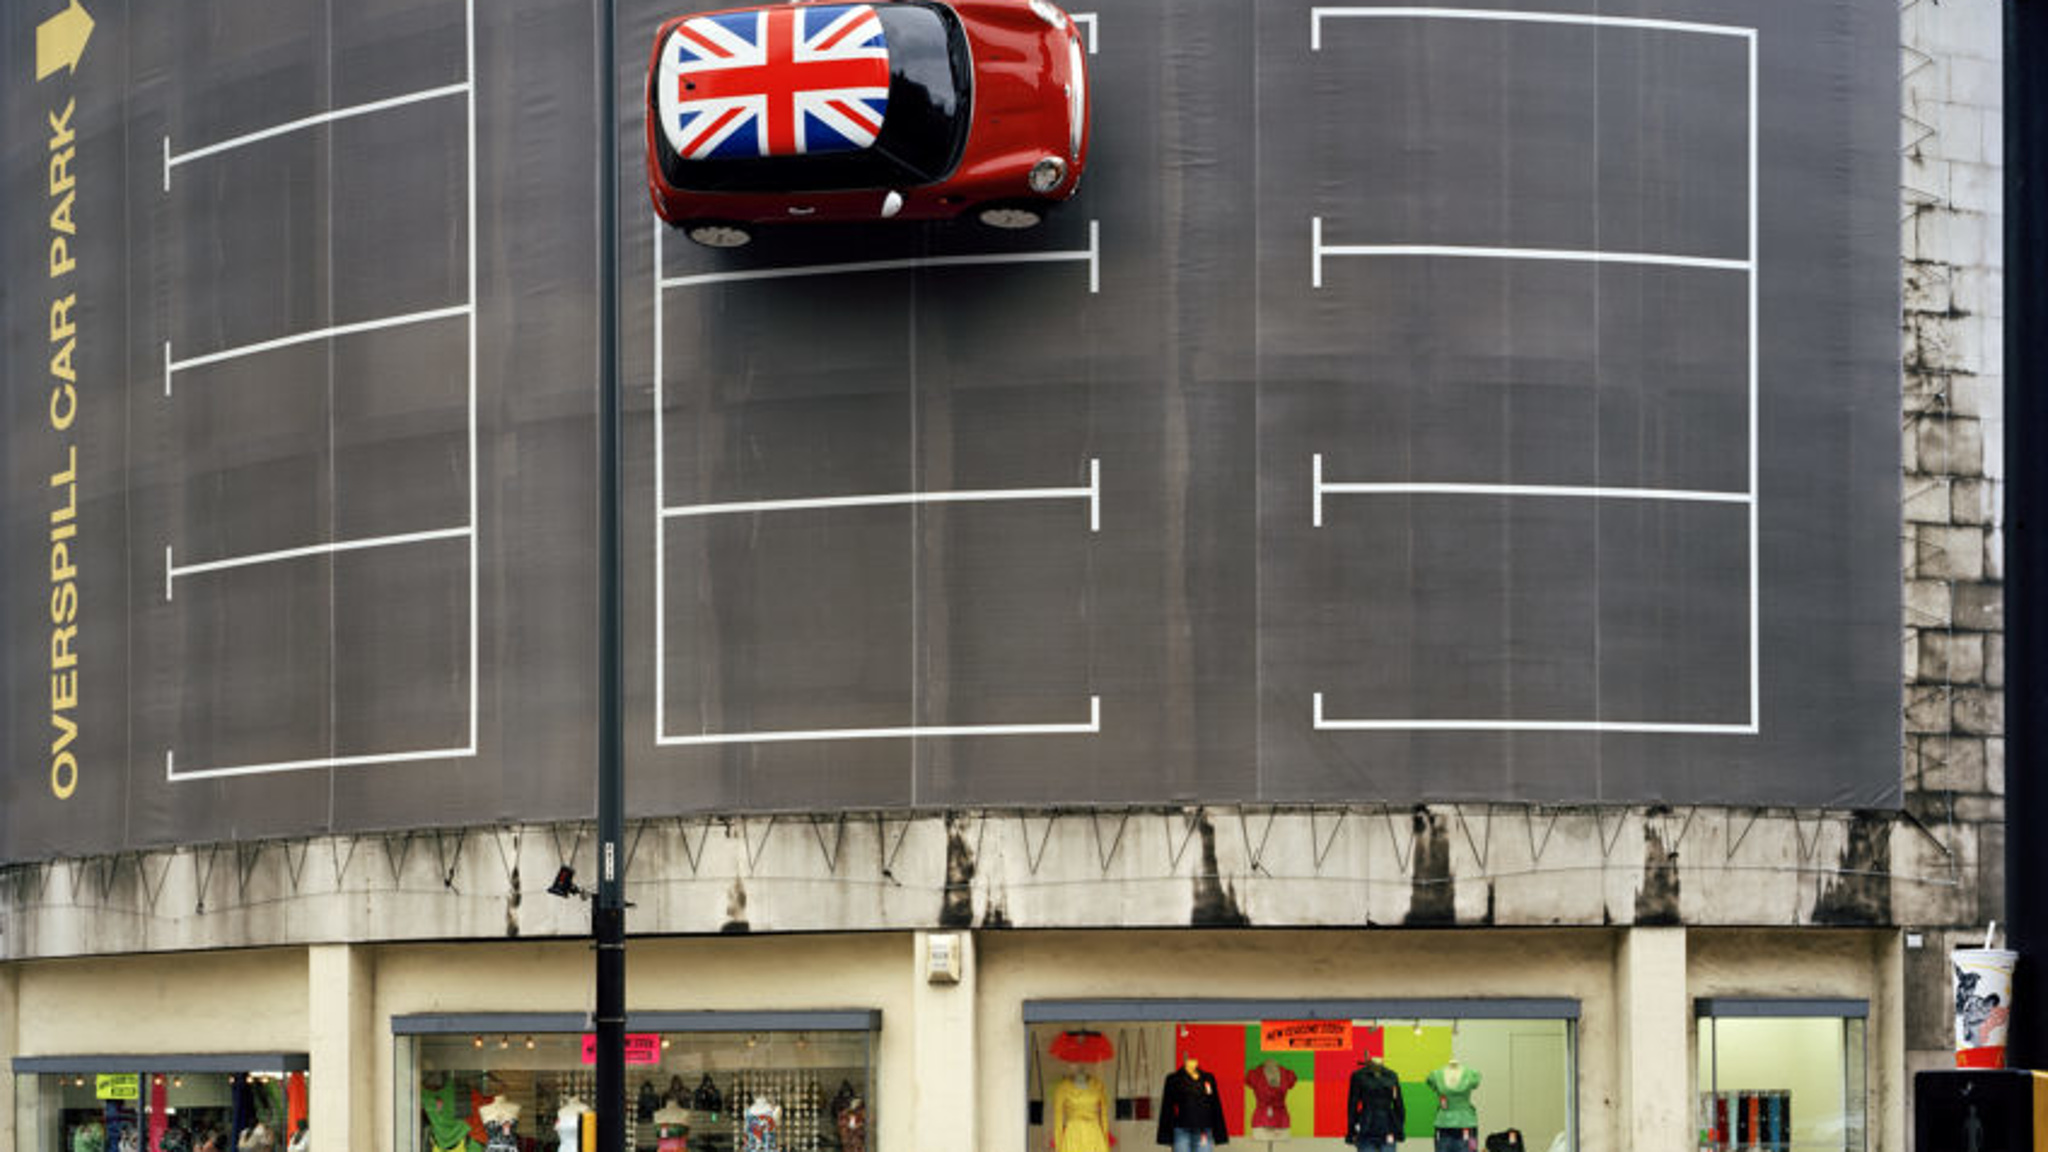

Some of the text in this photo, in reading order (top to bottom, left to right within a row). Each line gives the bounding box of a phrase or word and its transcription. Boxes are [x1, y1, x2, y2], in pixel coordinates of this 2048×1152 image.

[48, 97, 78, 800] OVERSPILL CAR PARK
